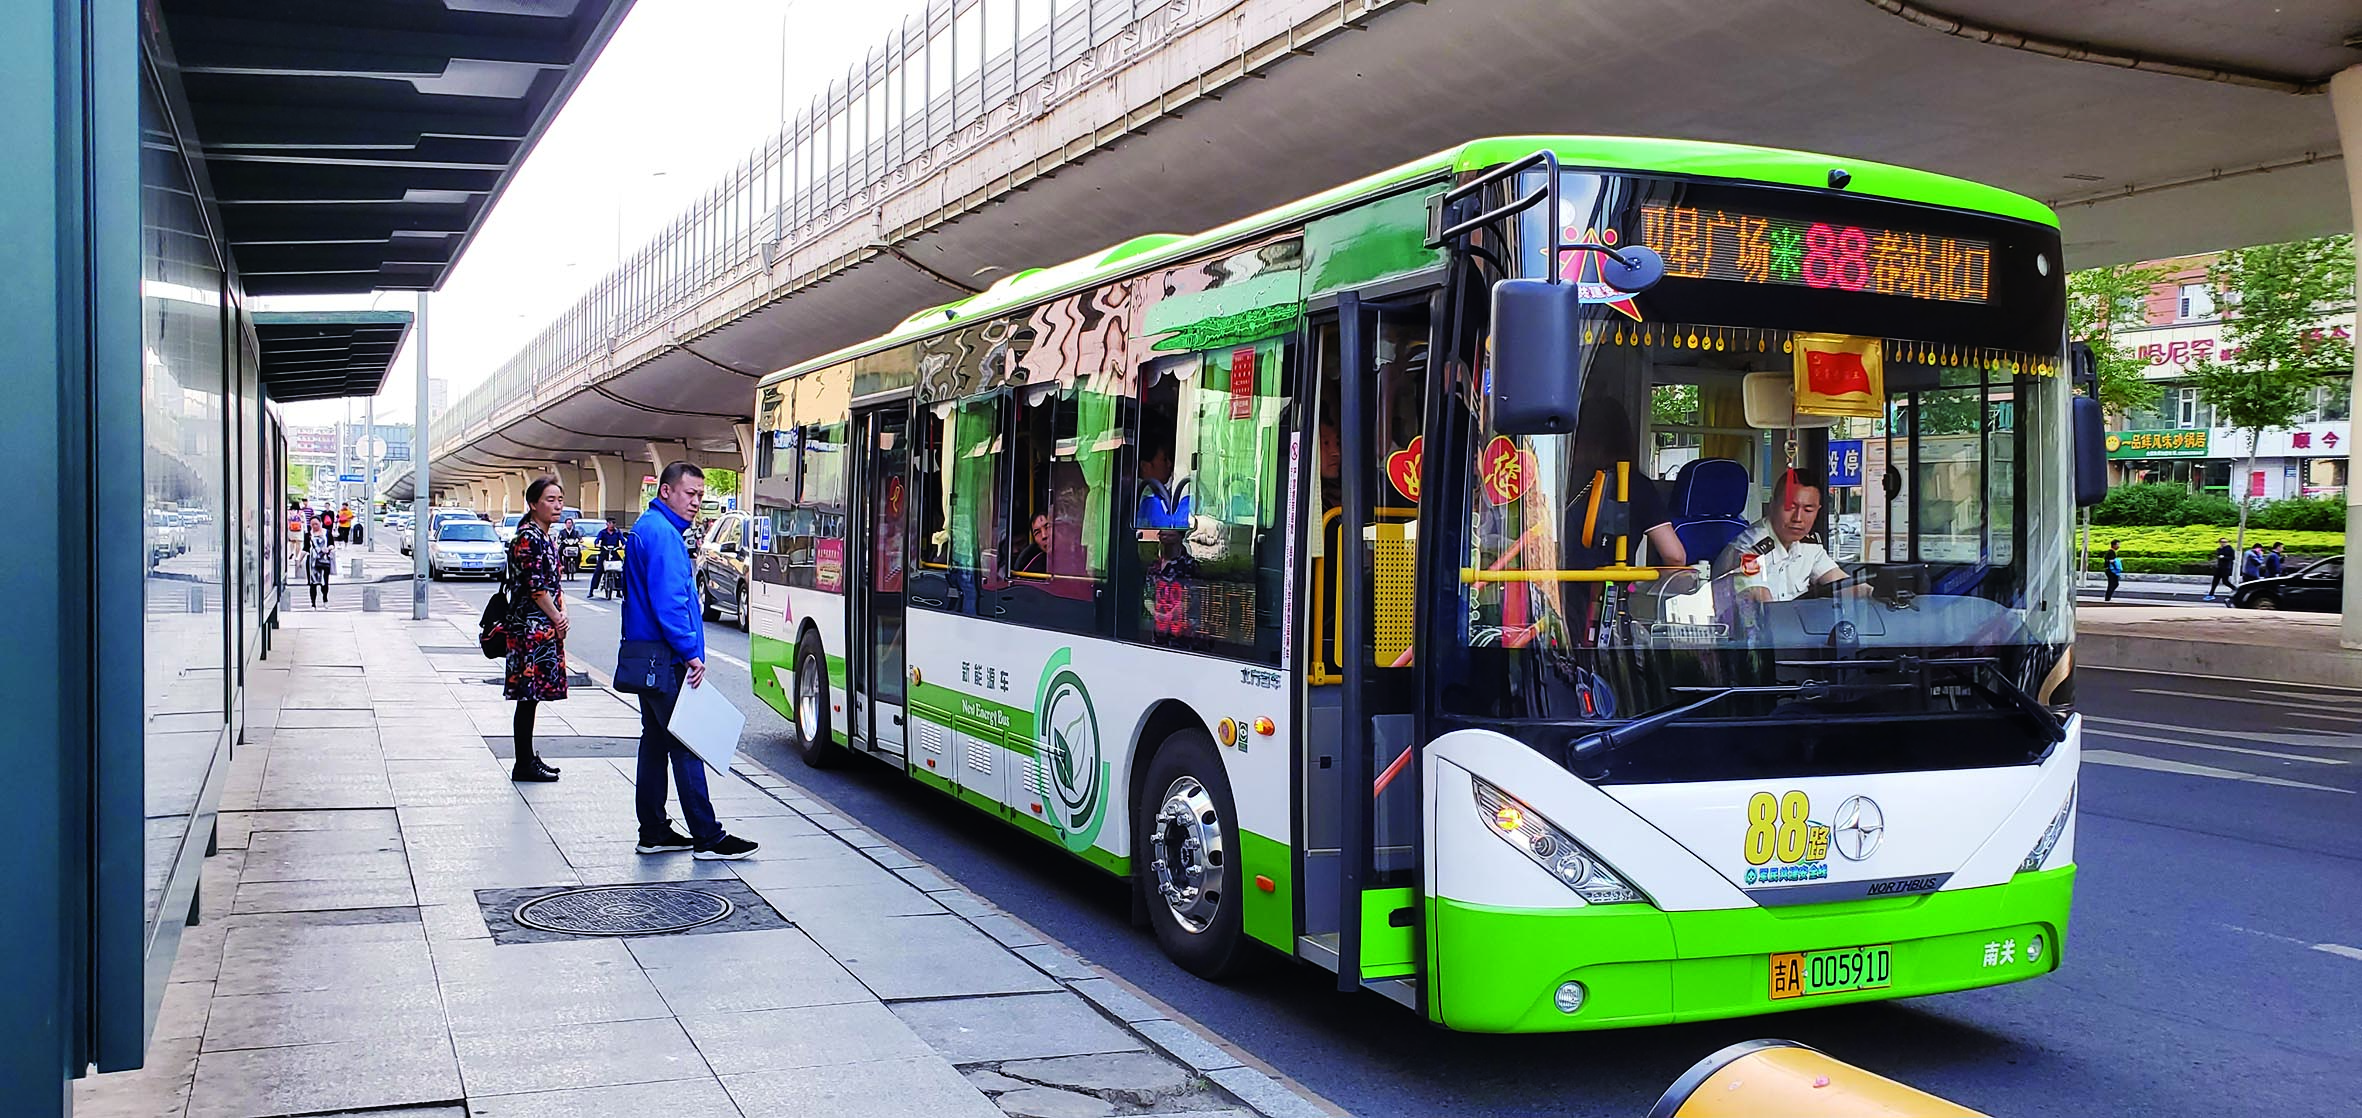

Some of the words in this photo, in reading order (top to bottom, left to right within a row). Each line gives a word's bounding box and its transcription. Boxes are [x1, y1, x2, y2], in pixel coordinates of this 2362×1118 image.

[1803, 222, 1869, 292] 88
[962, 661, 1009, 692] 新能源车
[975, 702, 998, 727] Energy
[997, 709, 1010, 728] Bus
[1867, 877, 1937, 897] NORTHBUS
[1983, 940, 2015, 967] 南关
